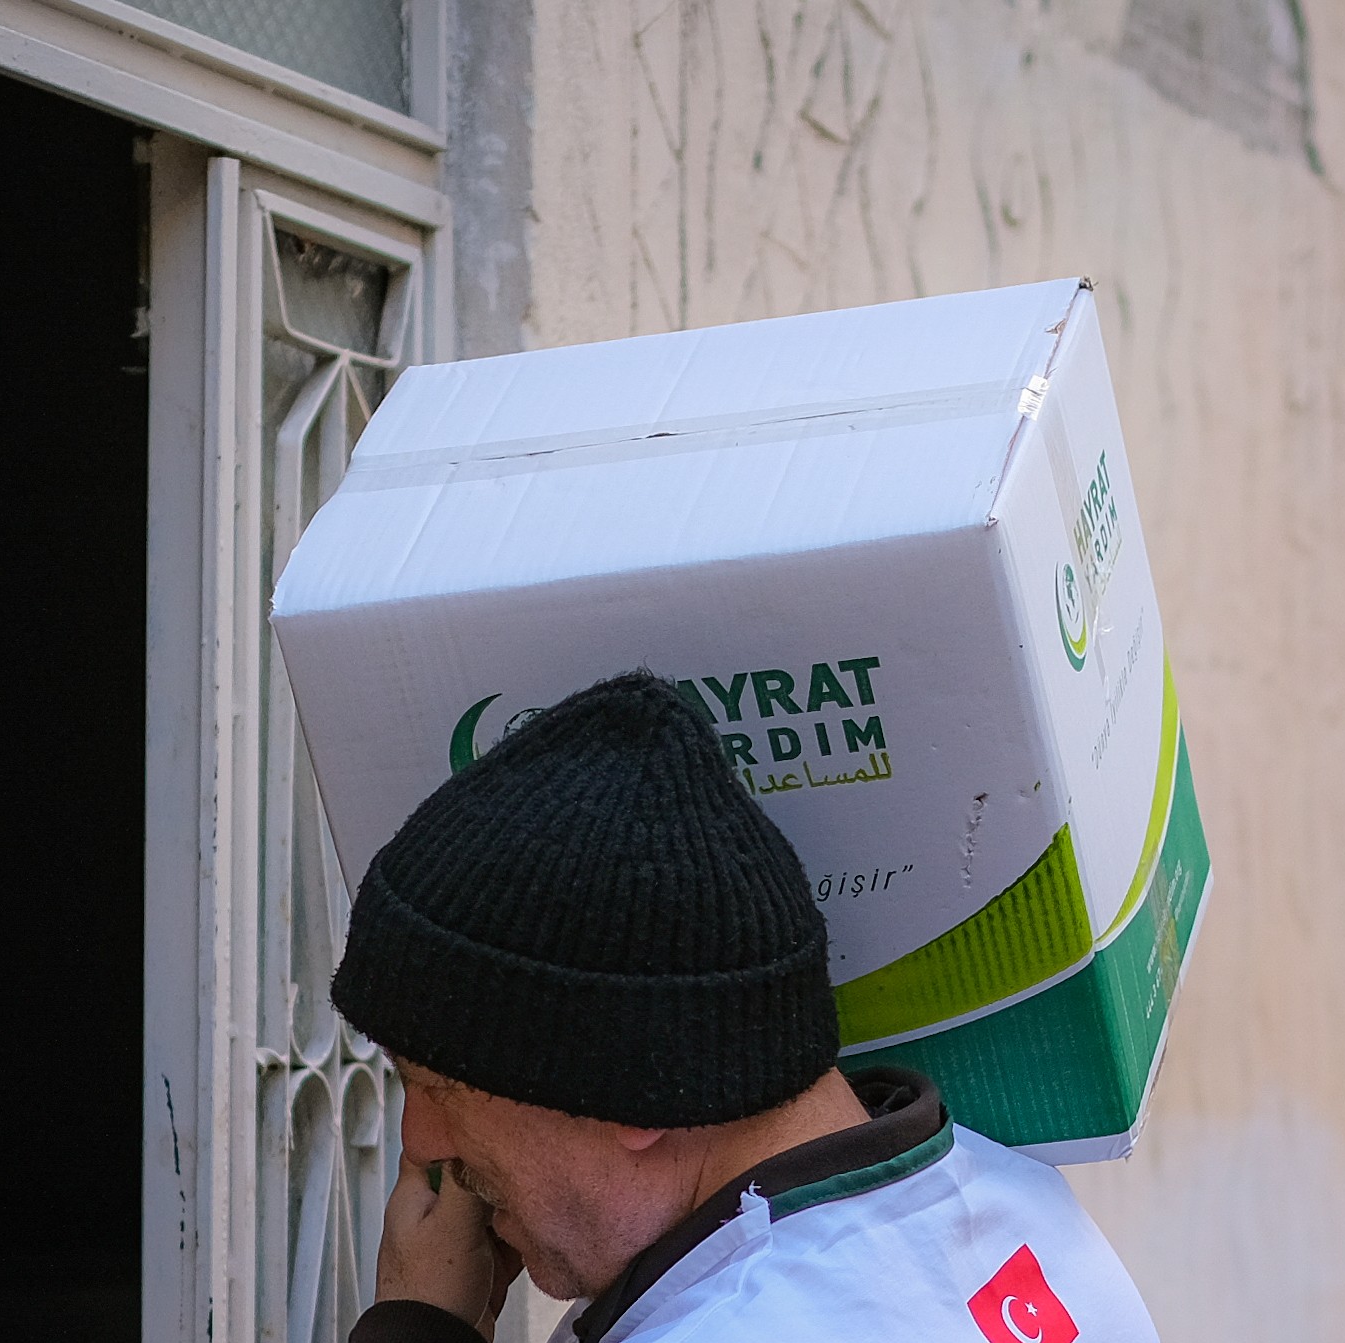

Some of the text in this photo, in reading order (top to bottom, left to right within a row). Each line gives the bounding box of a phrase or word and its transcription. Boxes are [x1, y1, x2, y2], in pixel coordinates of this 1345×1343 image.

[1073, 449, 1110, 564] HAYRAT
[676, 656, 880, 724] AYRAT
[721, 715, 886, 767] RDIM
[742, 752, 893, 796] للمساعدا
[816, 864, 914, 902] ğişir”
